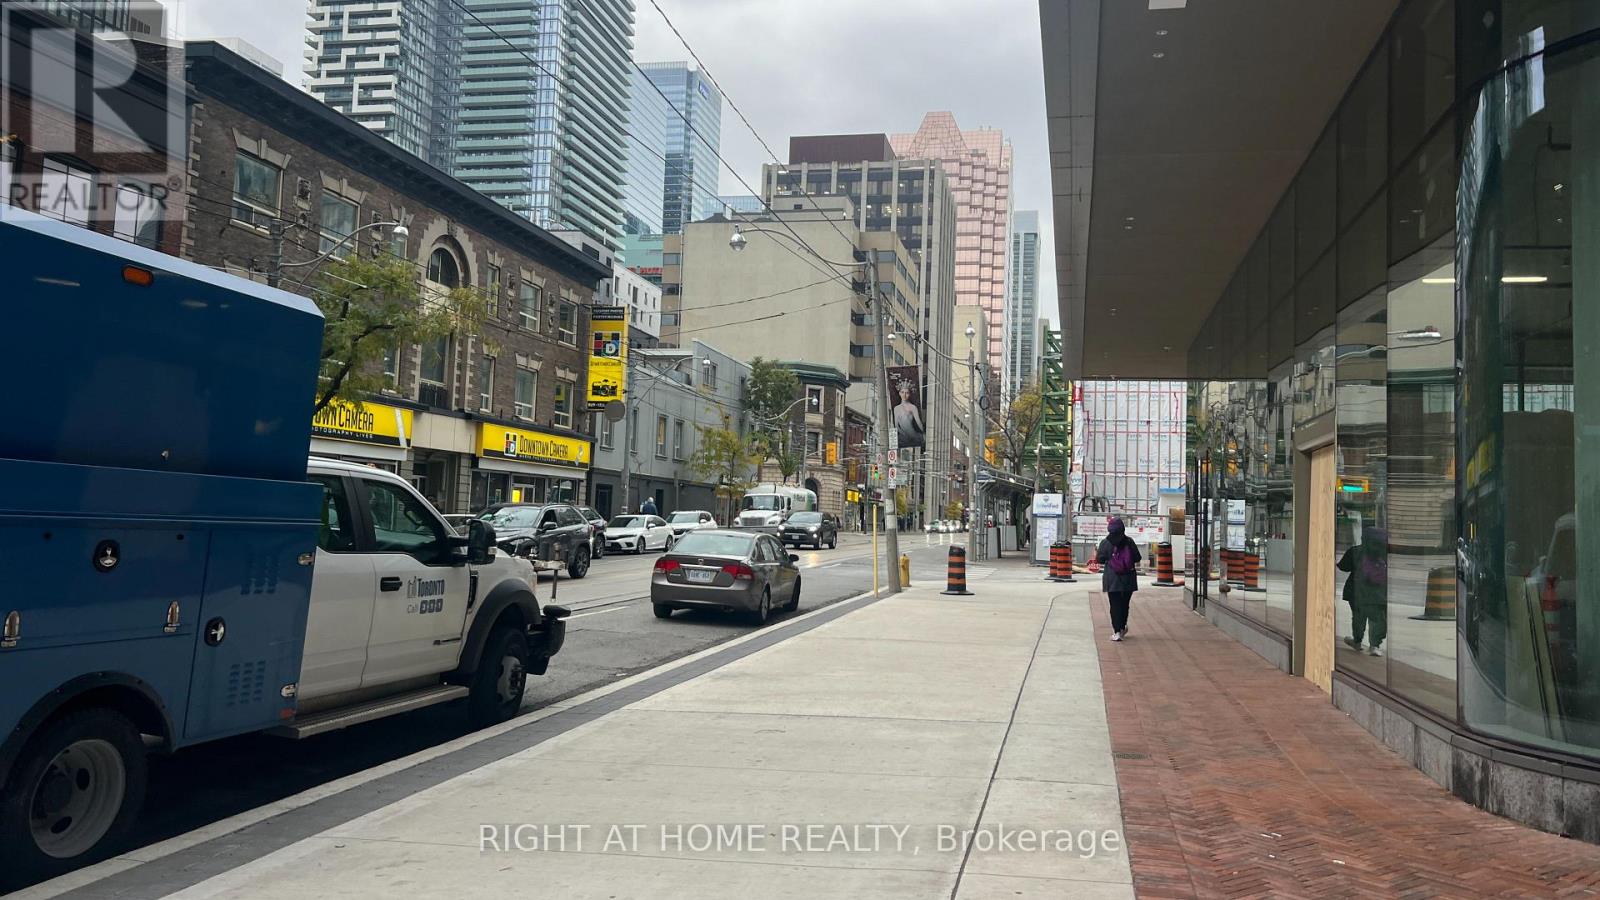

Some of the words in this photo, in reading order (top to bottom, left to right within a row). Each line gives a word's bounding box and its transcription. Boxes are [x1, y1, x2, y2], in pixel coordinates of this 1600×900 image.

[339, 404, 374, 432] CAMERA
[519, 435, 549, 456] DOWNTOWN
[550, 440, 568, 458] CAMERA
[418, 578, 445, 597] TORONTO
